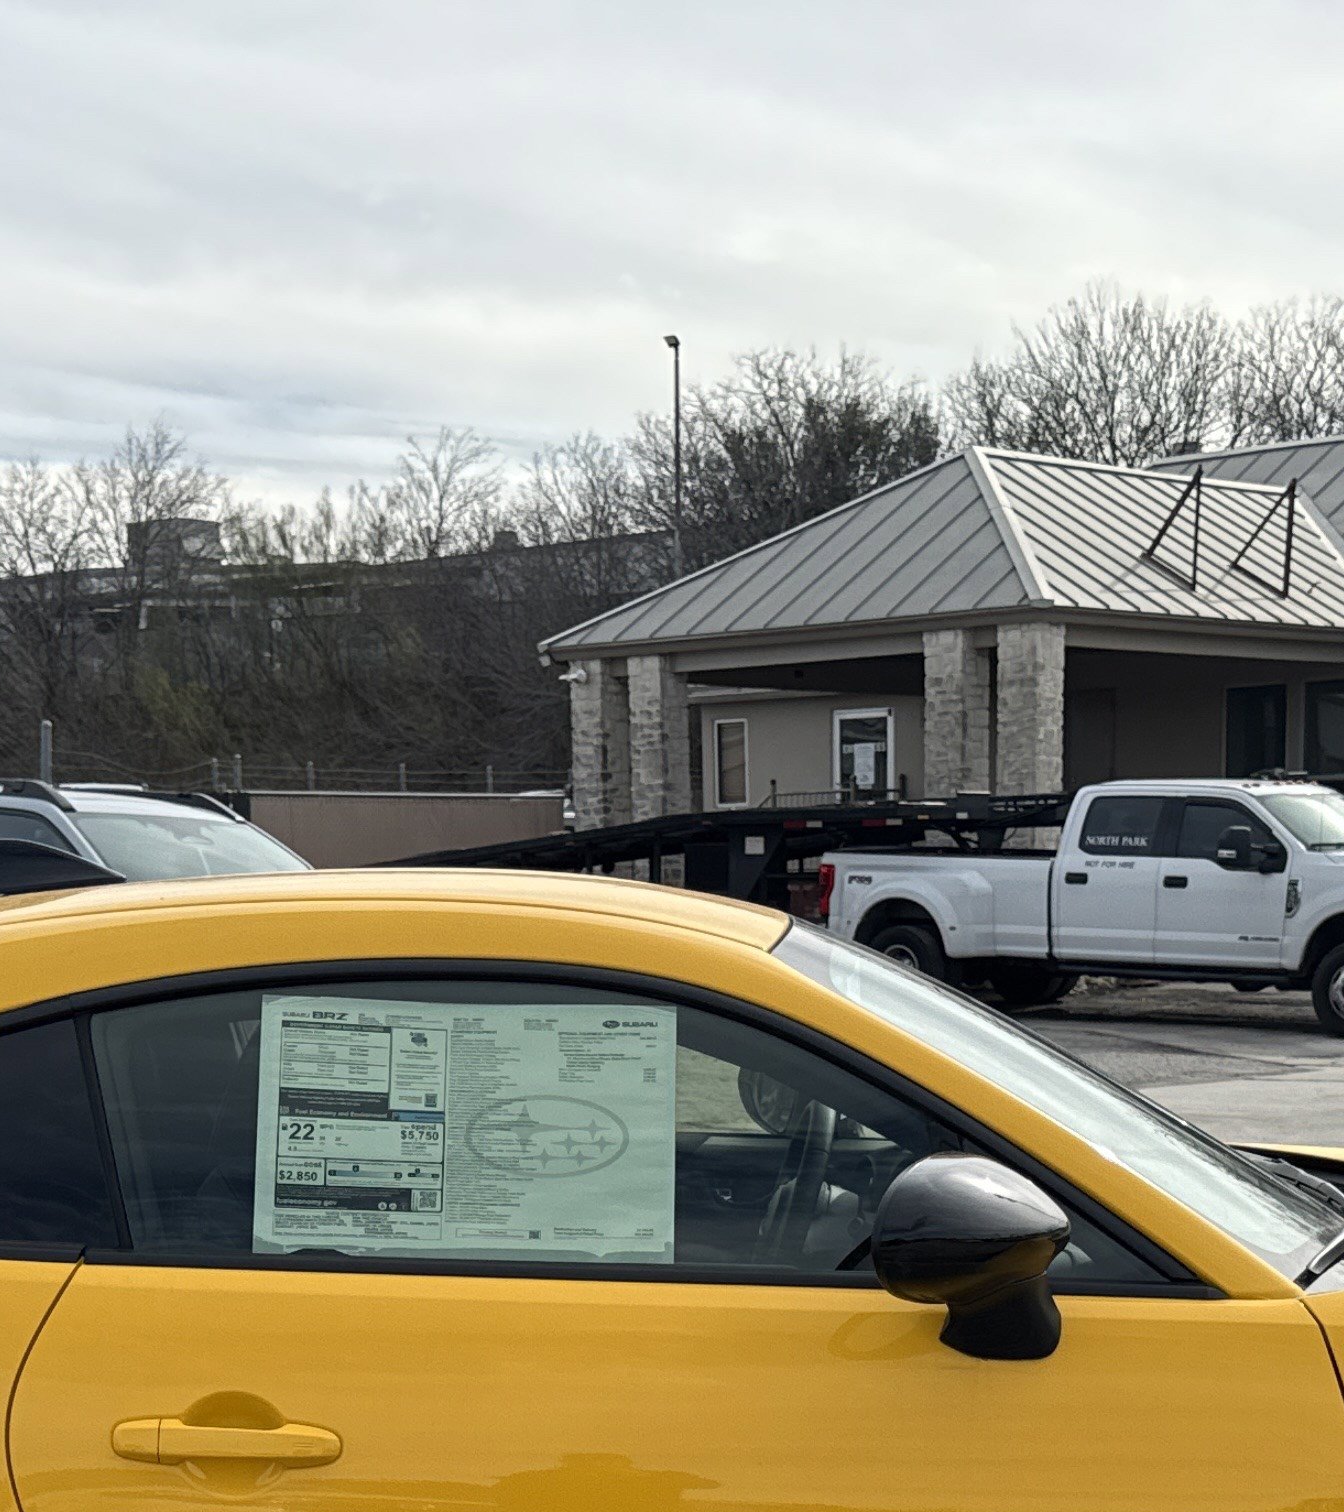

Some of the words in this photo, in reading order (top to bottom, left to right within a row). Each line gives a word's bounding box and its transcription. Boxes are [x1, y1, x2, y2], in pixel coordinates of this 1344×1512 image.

[1085, 835, 1119, 846] NORTH
[1122, 836, 1148, 847] PARK
[282, 1011, 310, 1019] SUBARU
[312, 1011, 349, 1021] BRZ
[289, 1123, 315, 1141] 22
[400, 1130, 439, 1142] $5,750
[279, 1170, 318, 1182] $2,850
